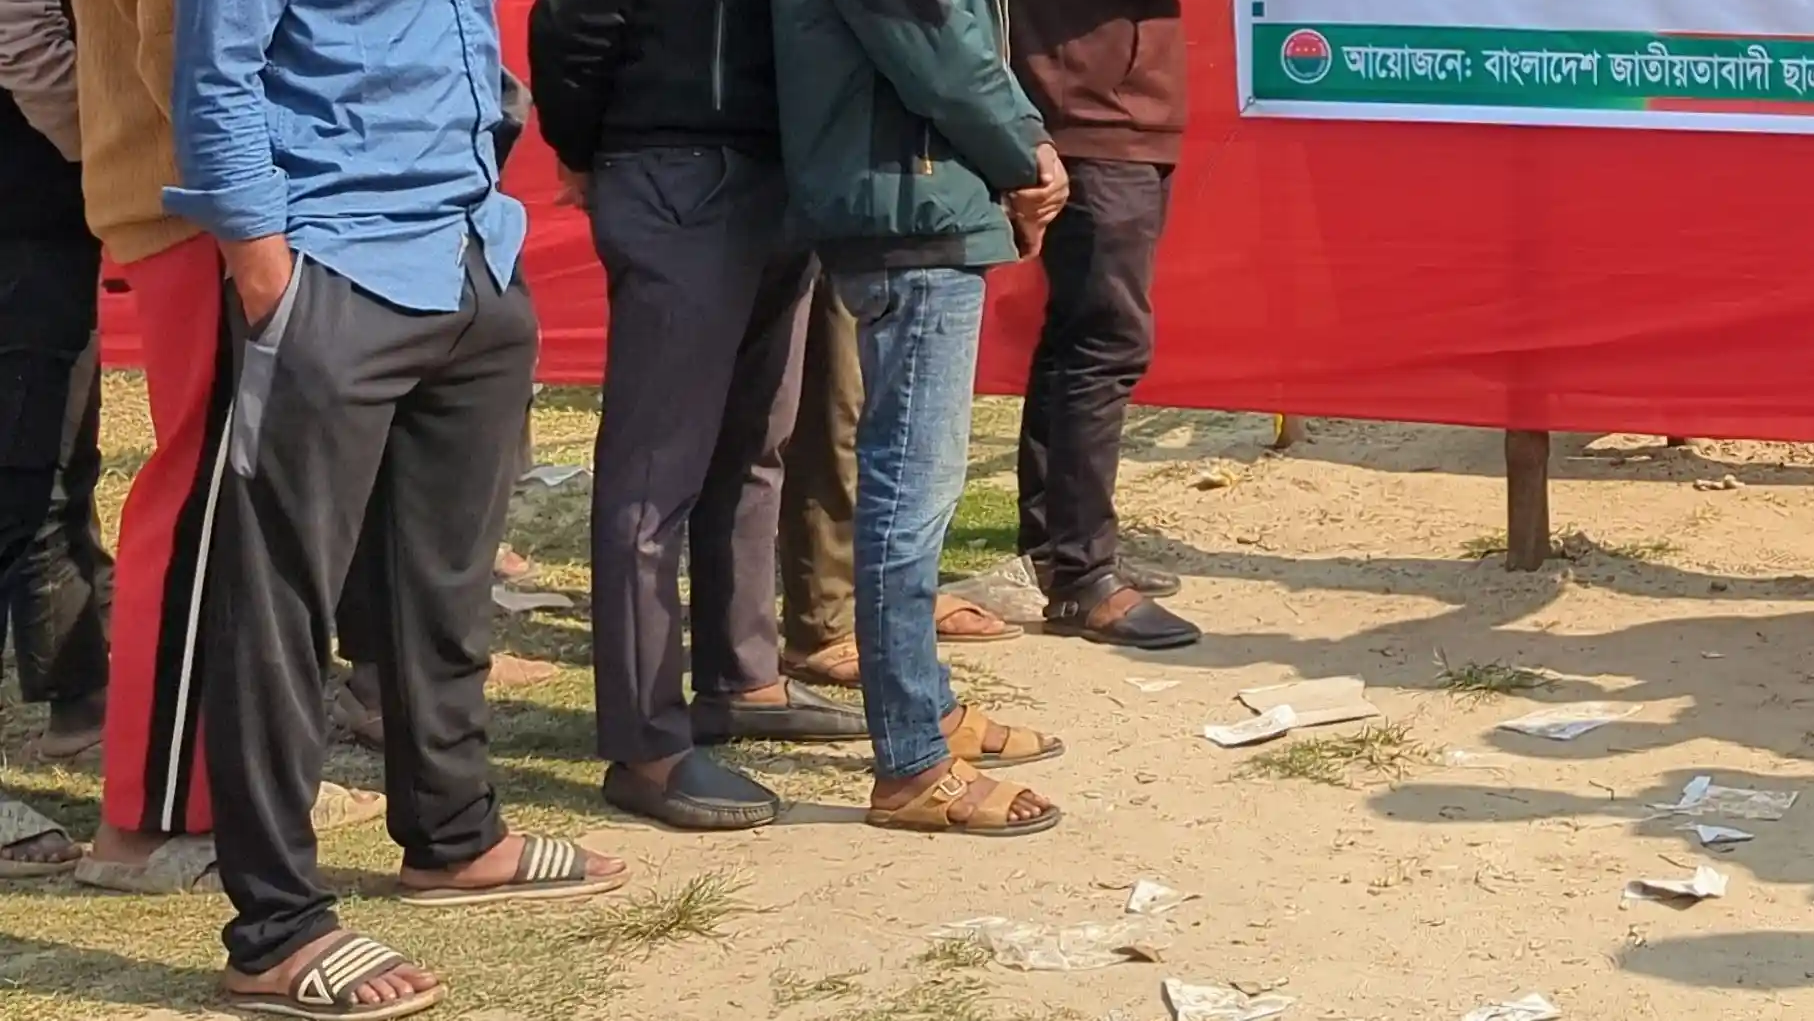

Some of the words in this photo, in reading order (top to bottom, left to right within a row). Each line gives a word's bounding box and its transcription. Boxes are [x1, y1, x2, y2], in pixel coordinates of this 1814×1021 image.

[1340, 43, 1472, 82] আয়োজনে:
[1482, 46, 1602, 87] বাংলাদেশ
[1607, 41, 1774, 91] জাতীয়তাবাদী
